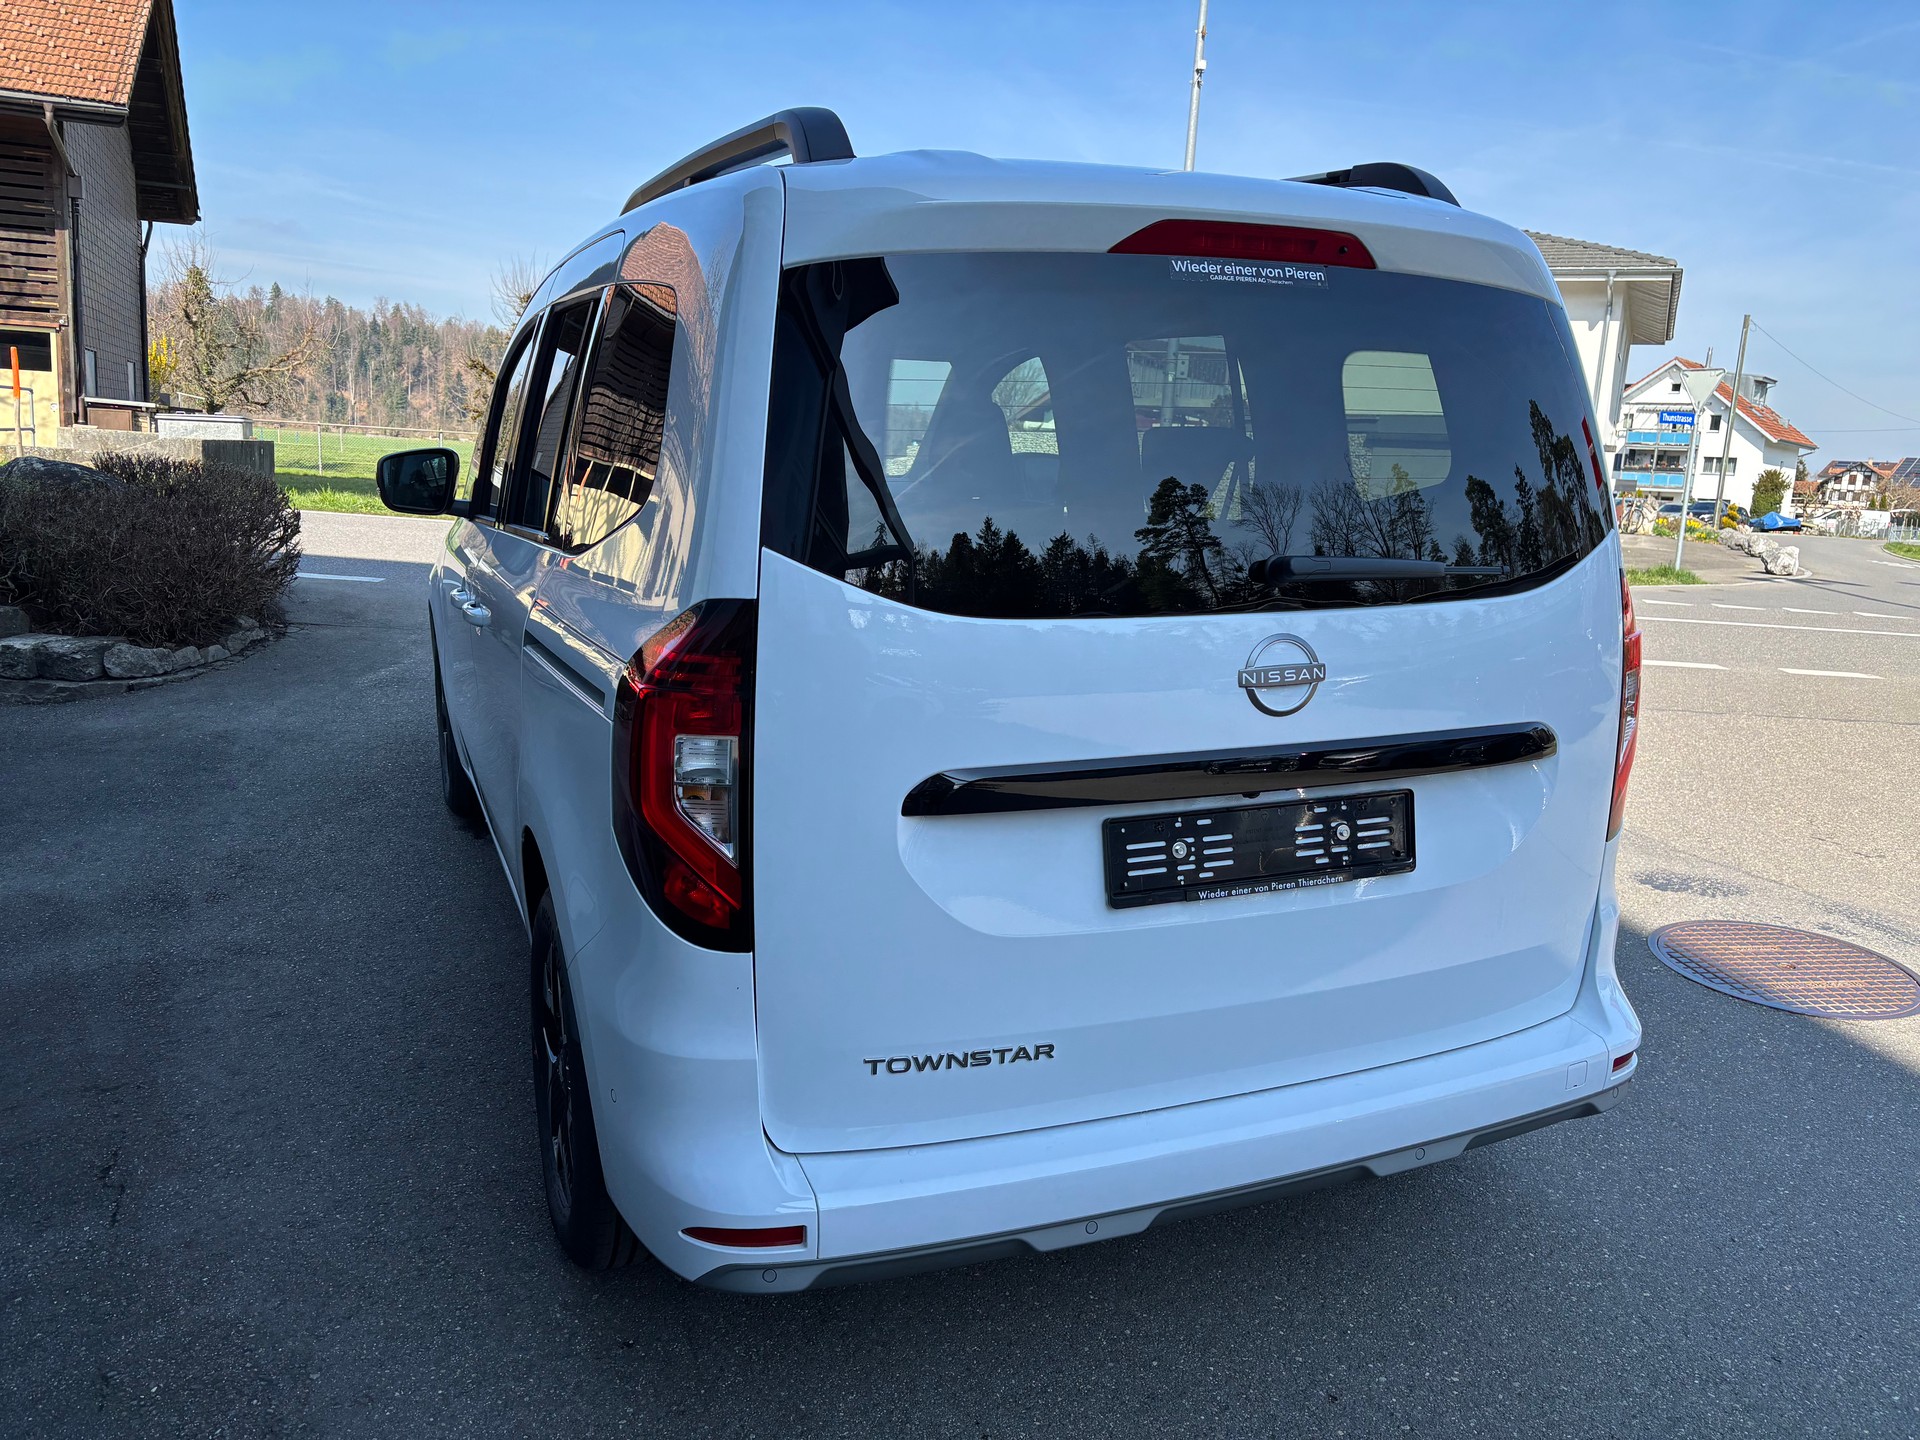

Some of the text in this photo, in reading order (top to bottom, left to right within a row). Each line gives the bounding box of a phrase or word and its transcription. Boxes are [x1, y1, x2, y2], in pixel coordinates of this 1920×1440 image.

[1171, 260, 1325, 281] Wieder einer von Pieren
[1209, 274, 1235, 282] GARAGE
[1235, 275, 1257, 283] PIEREN
[1662, 413, 1693, 423] Thunstrasse
[1242, 666, 1324, 685] NISSAN
[1198, 875, 1344, 900] Wieder einer von Pieren Thierachern
[863, 1042, 1056, 1076] TOWNSTAR
